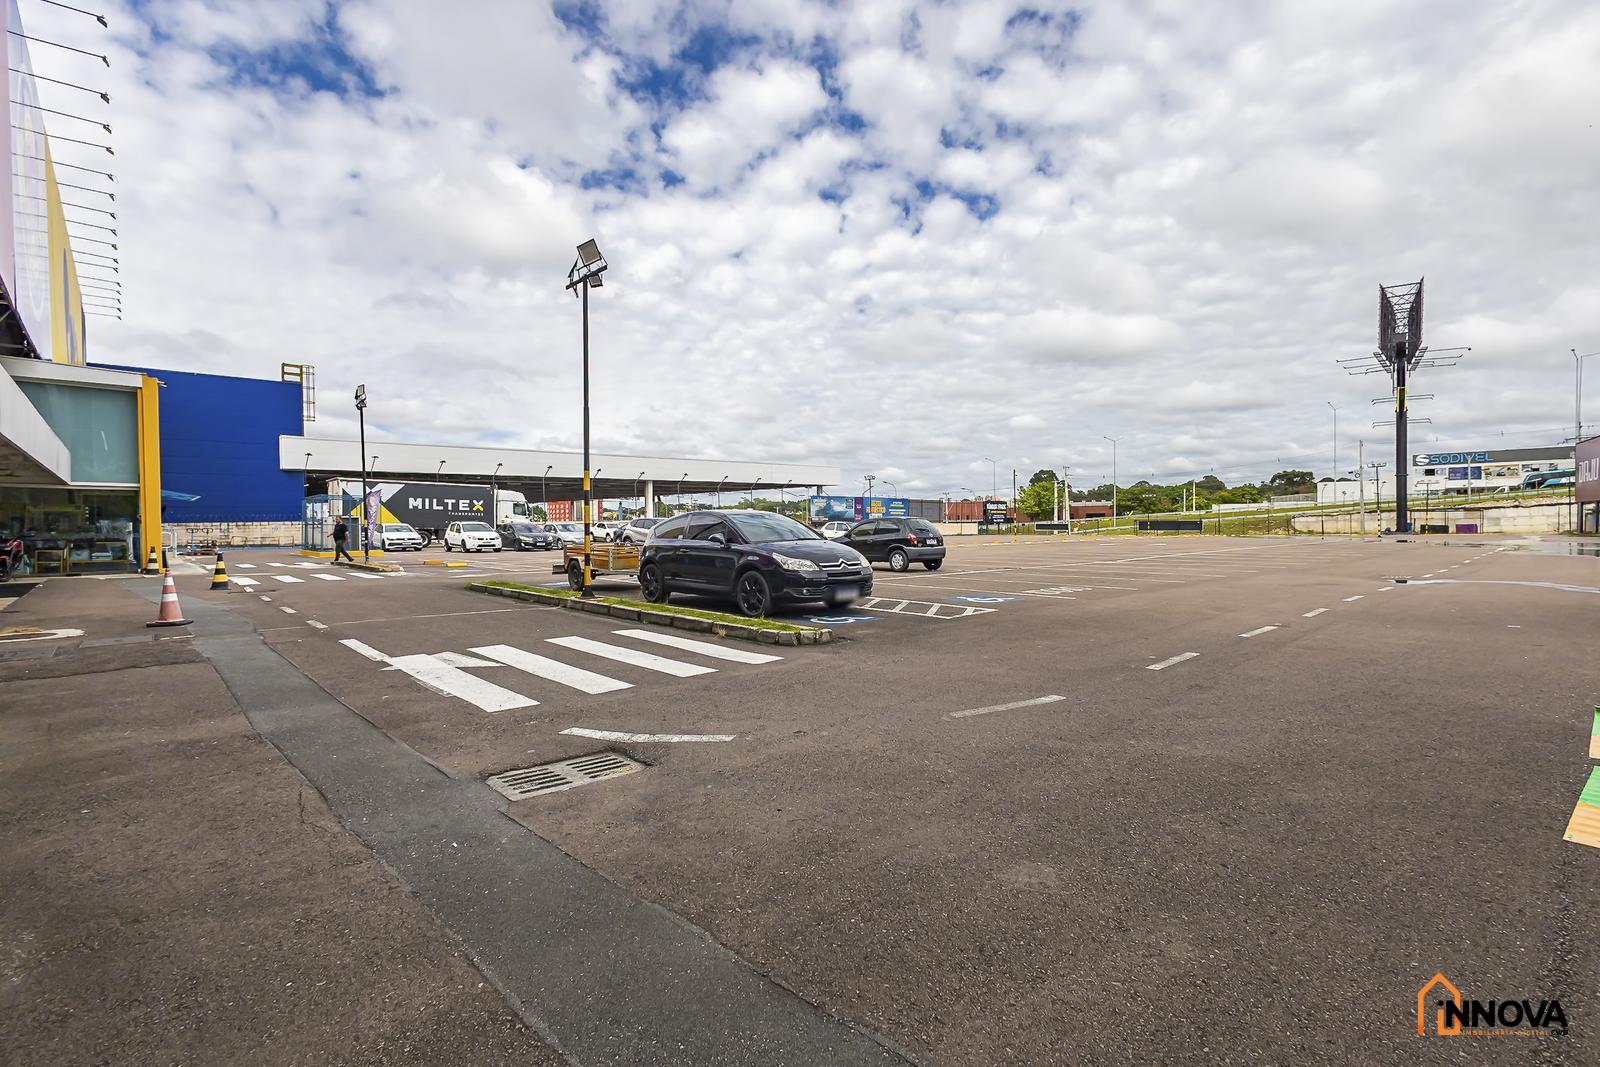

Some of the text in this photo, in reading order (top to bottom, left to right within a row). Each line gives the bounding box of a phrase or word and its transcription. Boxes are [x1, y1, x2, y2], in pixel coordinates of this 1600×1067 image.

[1430, 452, 1494, 464] SODIVEL
[1579, 457, 1599, 483] DAJU
[408, 497, 484, 512] MILTEX
